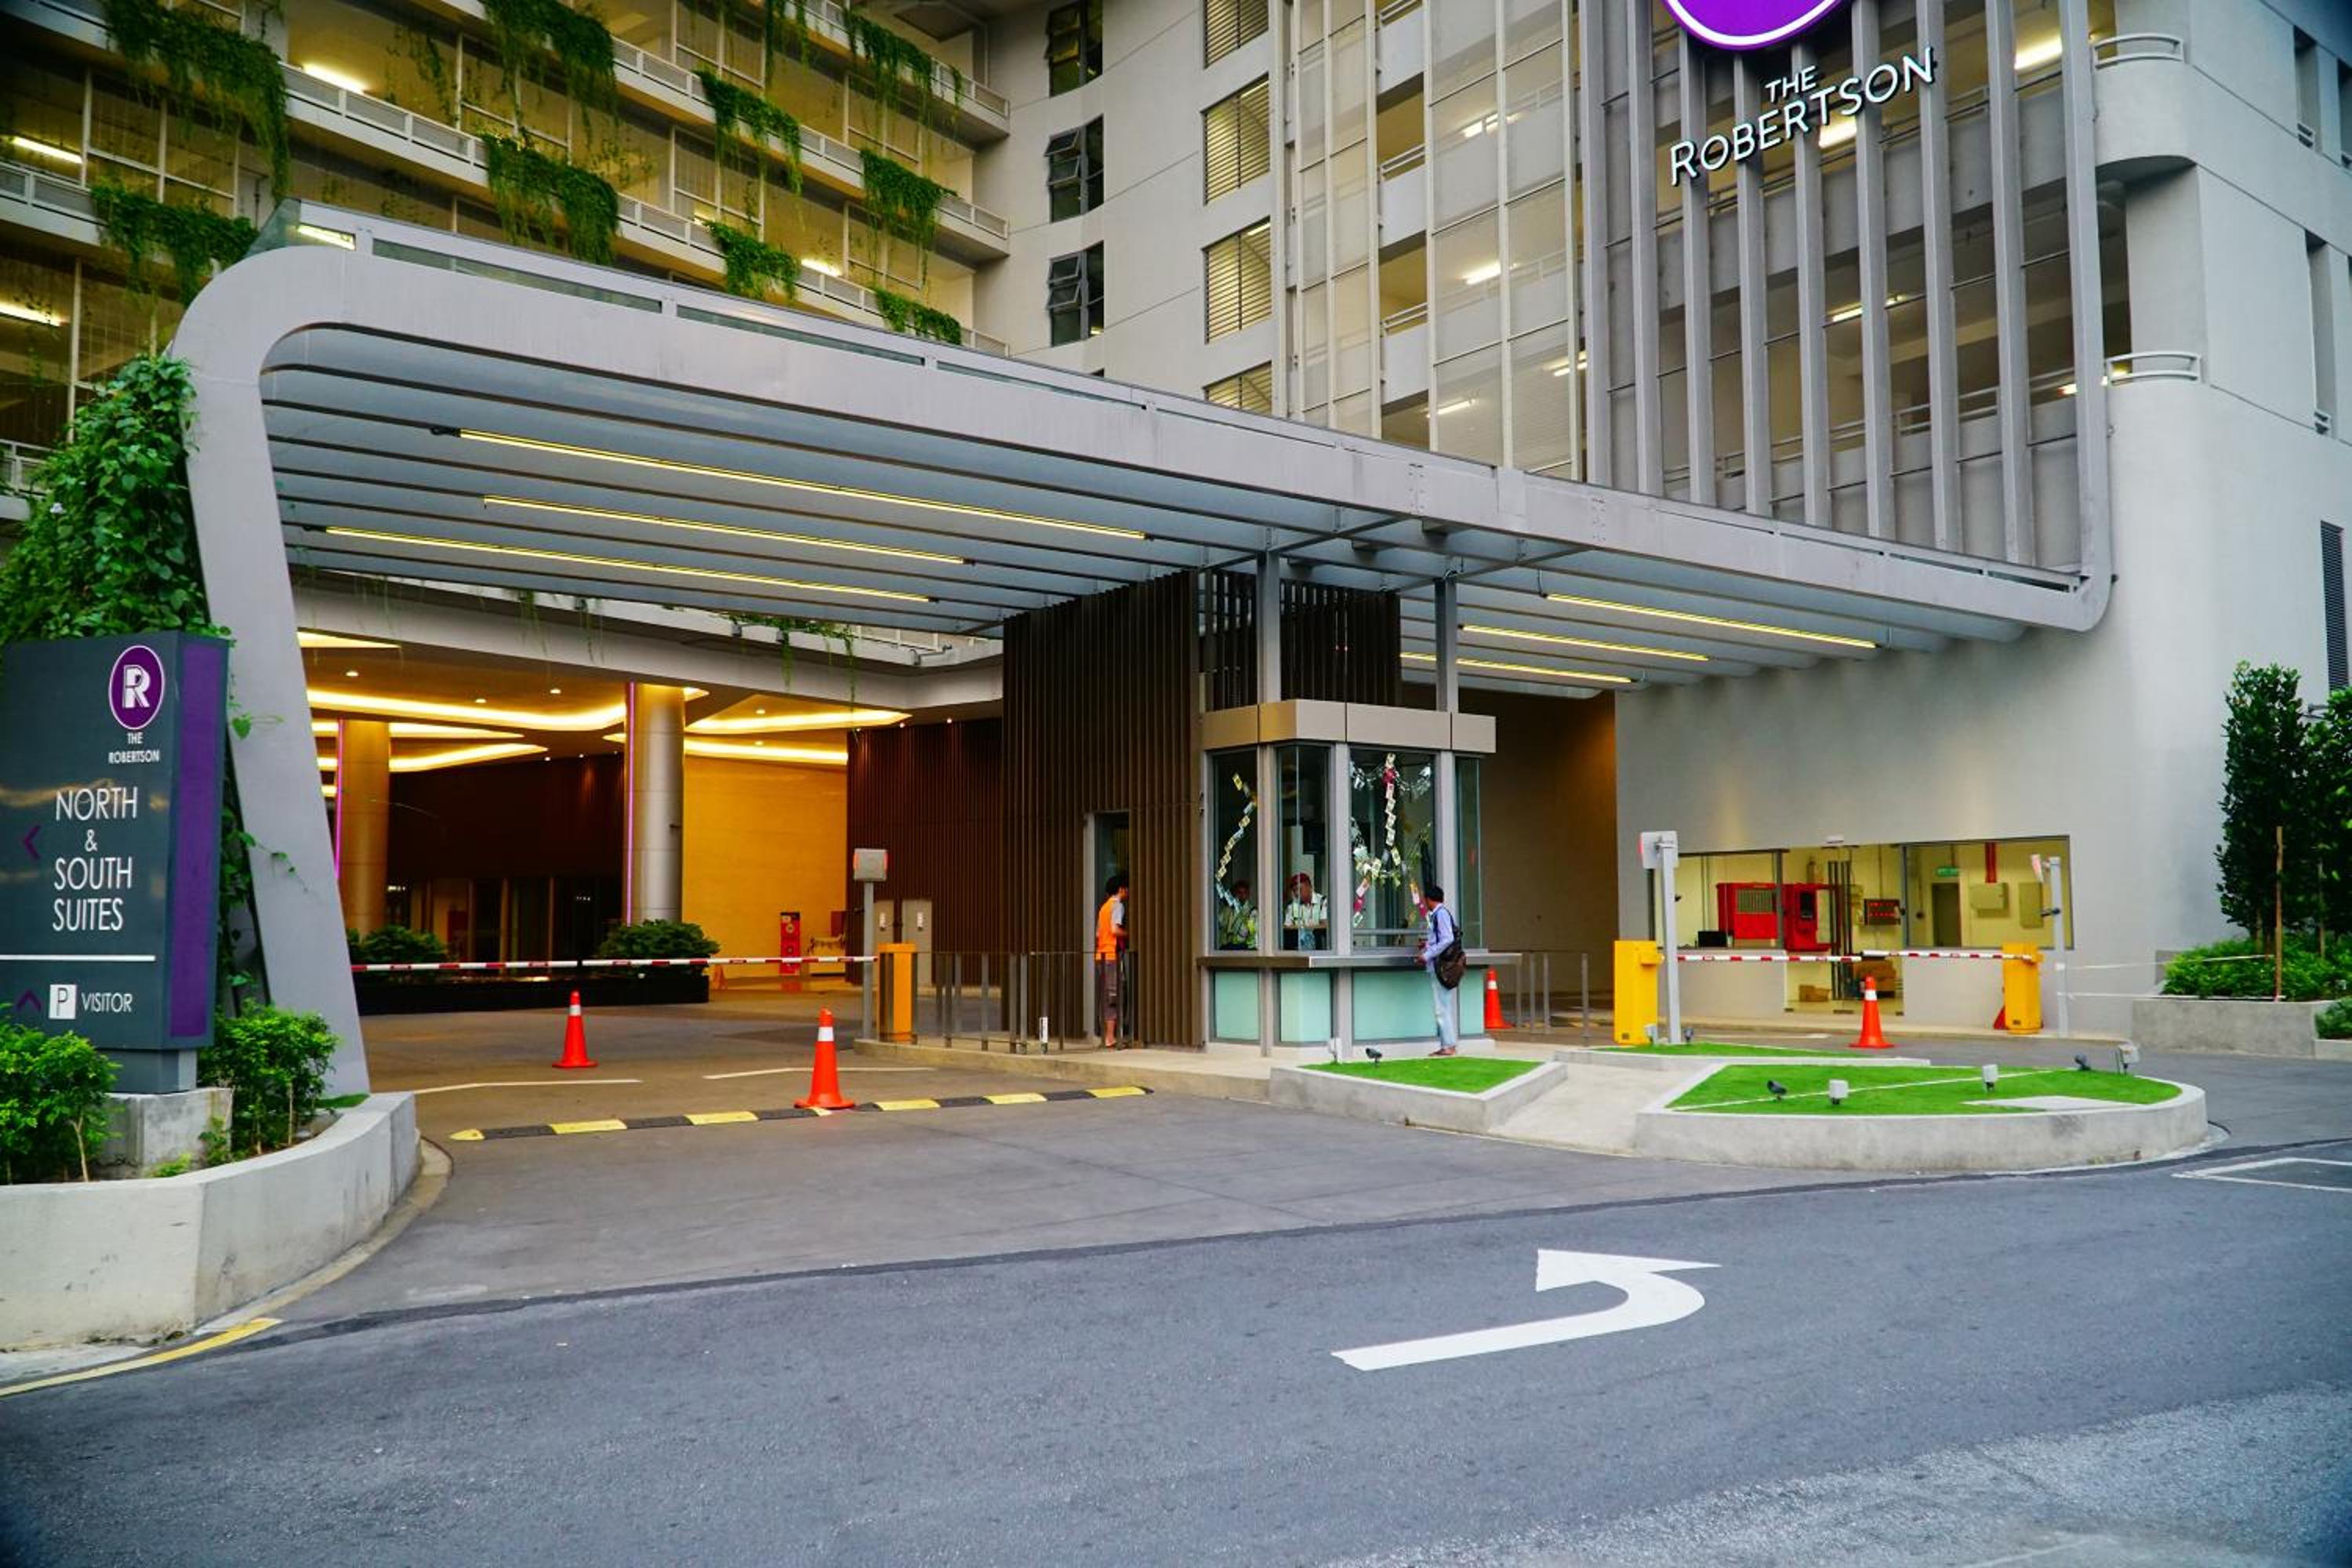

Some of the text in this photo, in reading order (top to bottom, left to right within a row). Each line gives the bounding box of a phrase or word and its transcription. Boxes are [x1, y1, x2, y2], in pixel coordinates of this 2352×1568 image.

[1765, 64, 1818, 104] THE
[1669, 45, 1935, 187] ROBERTSON
[122, 665, 151, 708] R
[127, 732, 143, 745] THE
[108, 749, 160, 764] ROBERTSON
[55, 786, 138, 822] NORTH
[84, 829, 98, 852] &
[53, 857, 132, 891] SOUTH
[52, 898, 124, 932] SUITES
[56, 987, 132, 1017] P VISITOR
